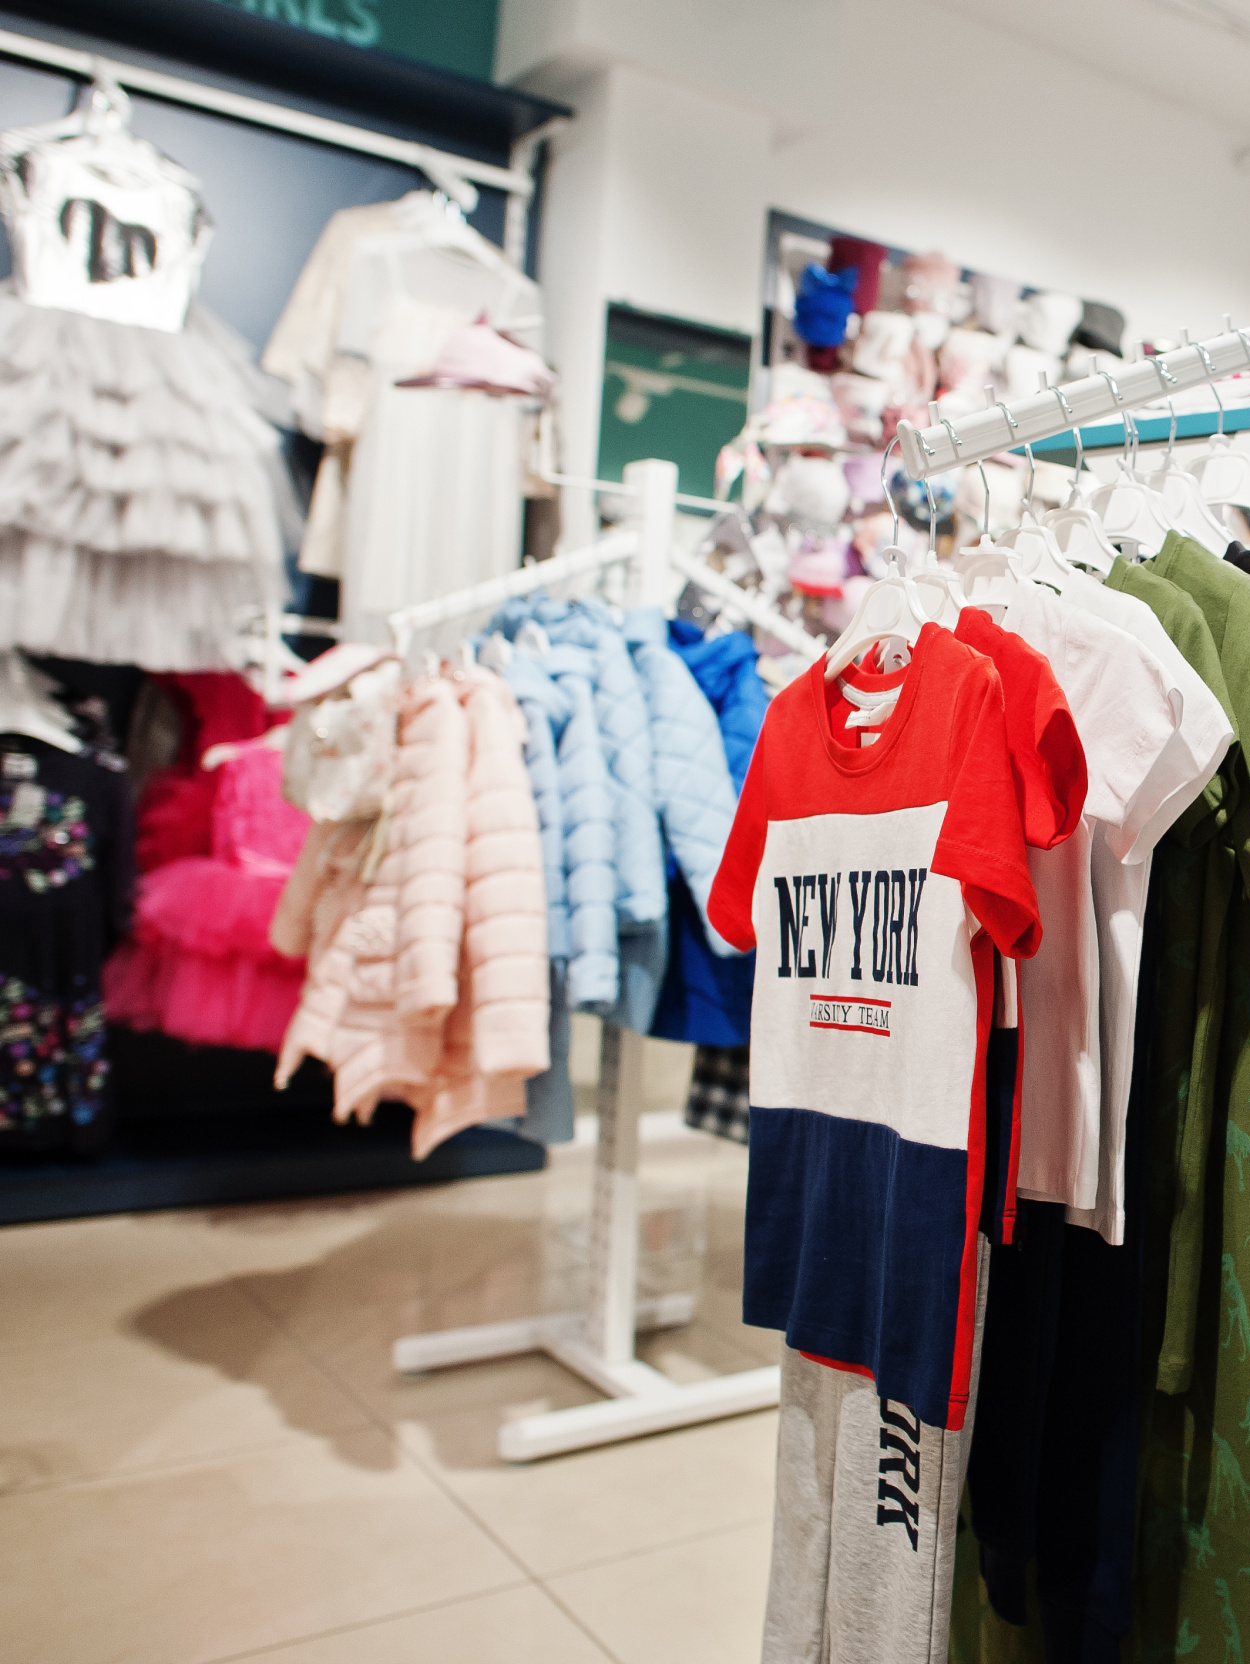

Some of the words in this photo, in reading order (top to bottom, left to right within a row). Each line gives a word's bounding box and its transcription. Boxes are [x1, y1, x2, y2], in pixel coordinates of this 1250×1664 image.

[848, 868, 928, 986] YORK
[857, 1006, 890, 1029] TEAM
[877, 1396, 921, 1553] ORK
